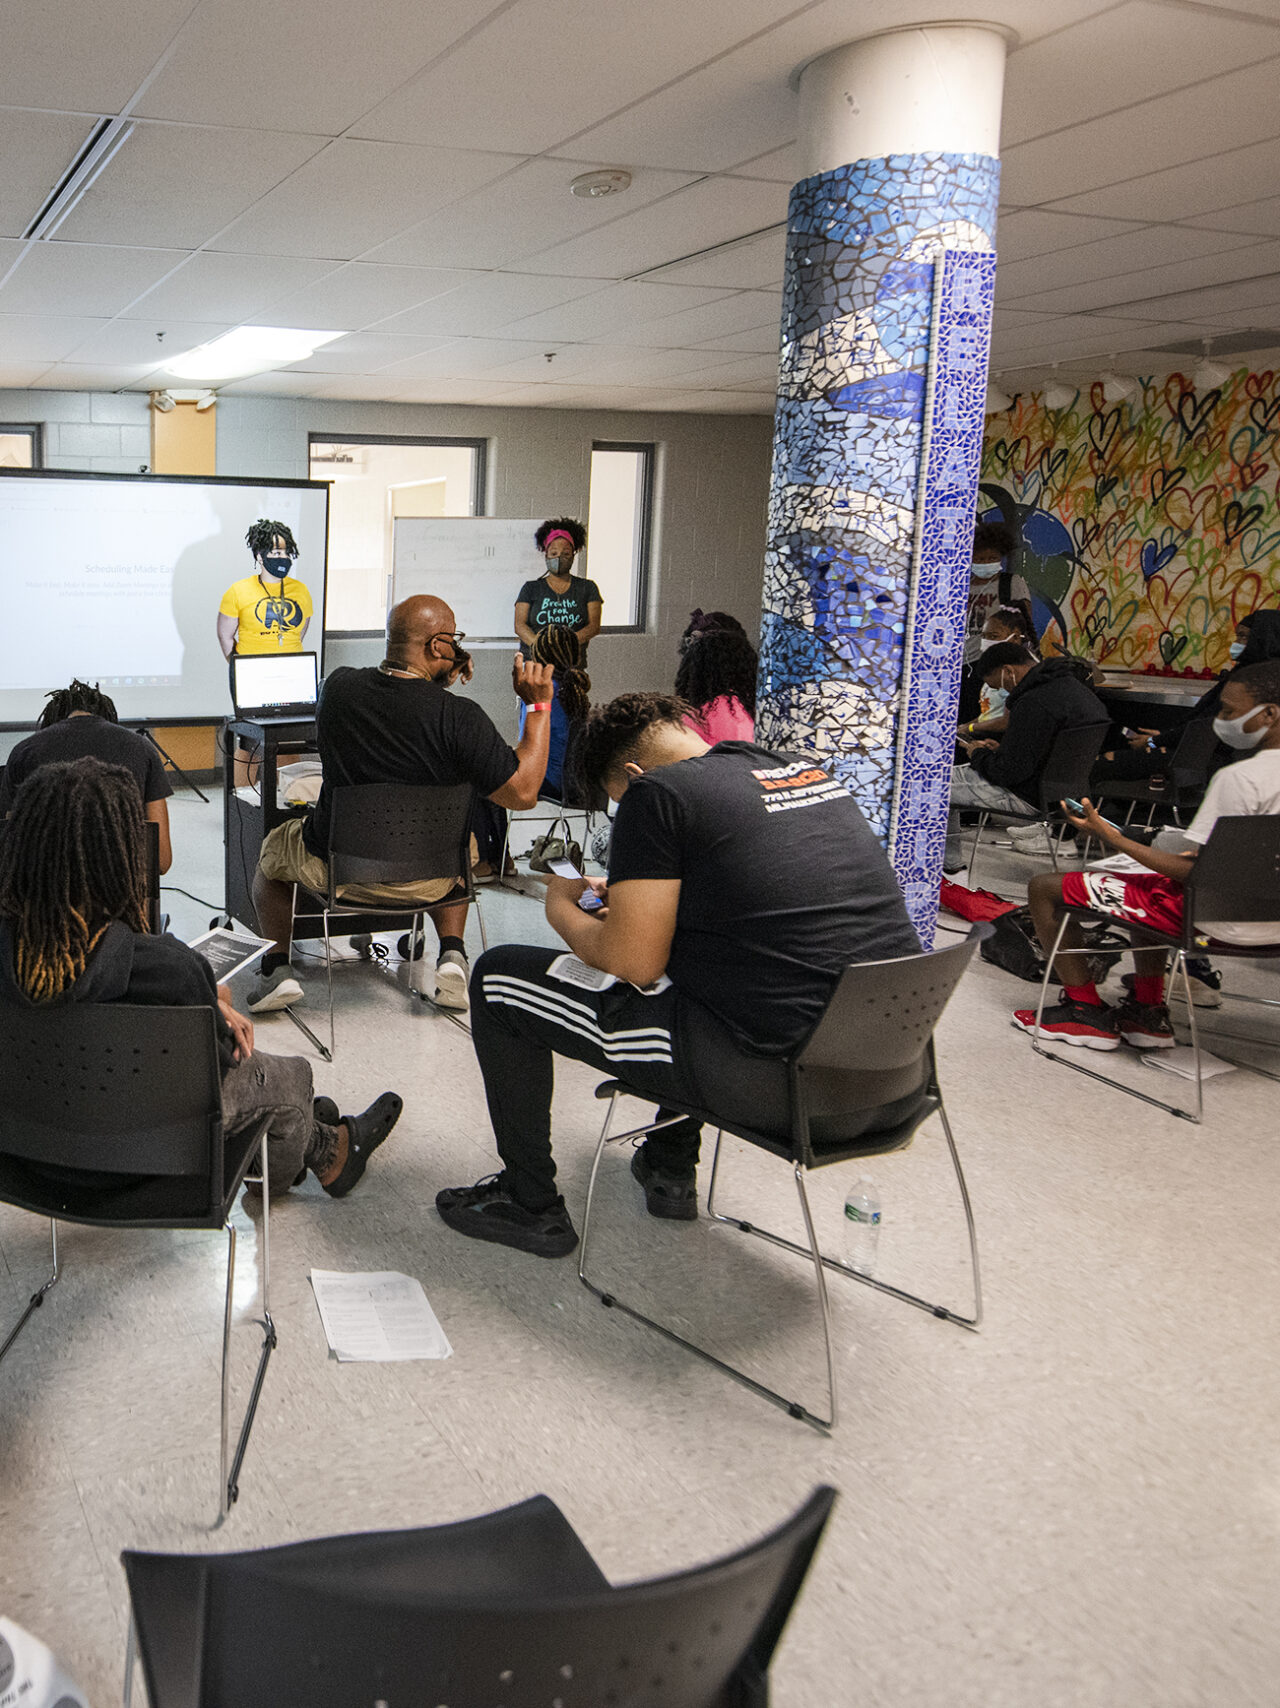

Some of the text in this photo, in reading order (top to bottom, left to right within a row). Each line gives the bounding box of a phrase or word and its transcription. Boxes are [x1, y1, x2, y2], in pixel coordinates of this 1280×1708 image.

[85, 564, 132, 575] Scheduling
[134, 564, 158, 574] Made
[541, 597, 578, 610] Breathe
[536, 610, 582, 628] Change
